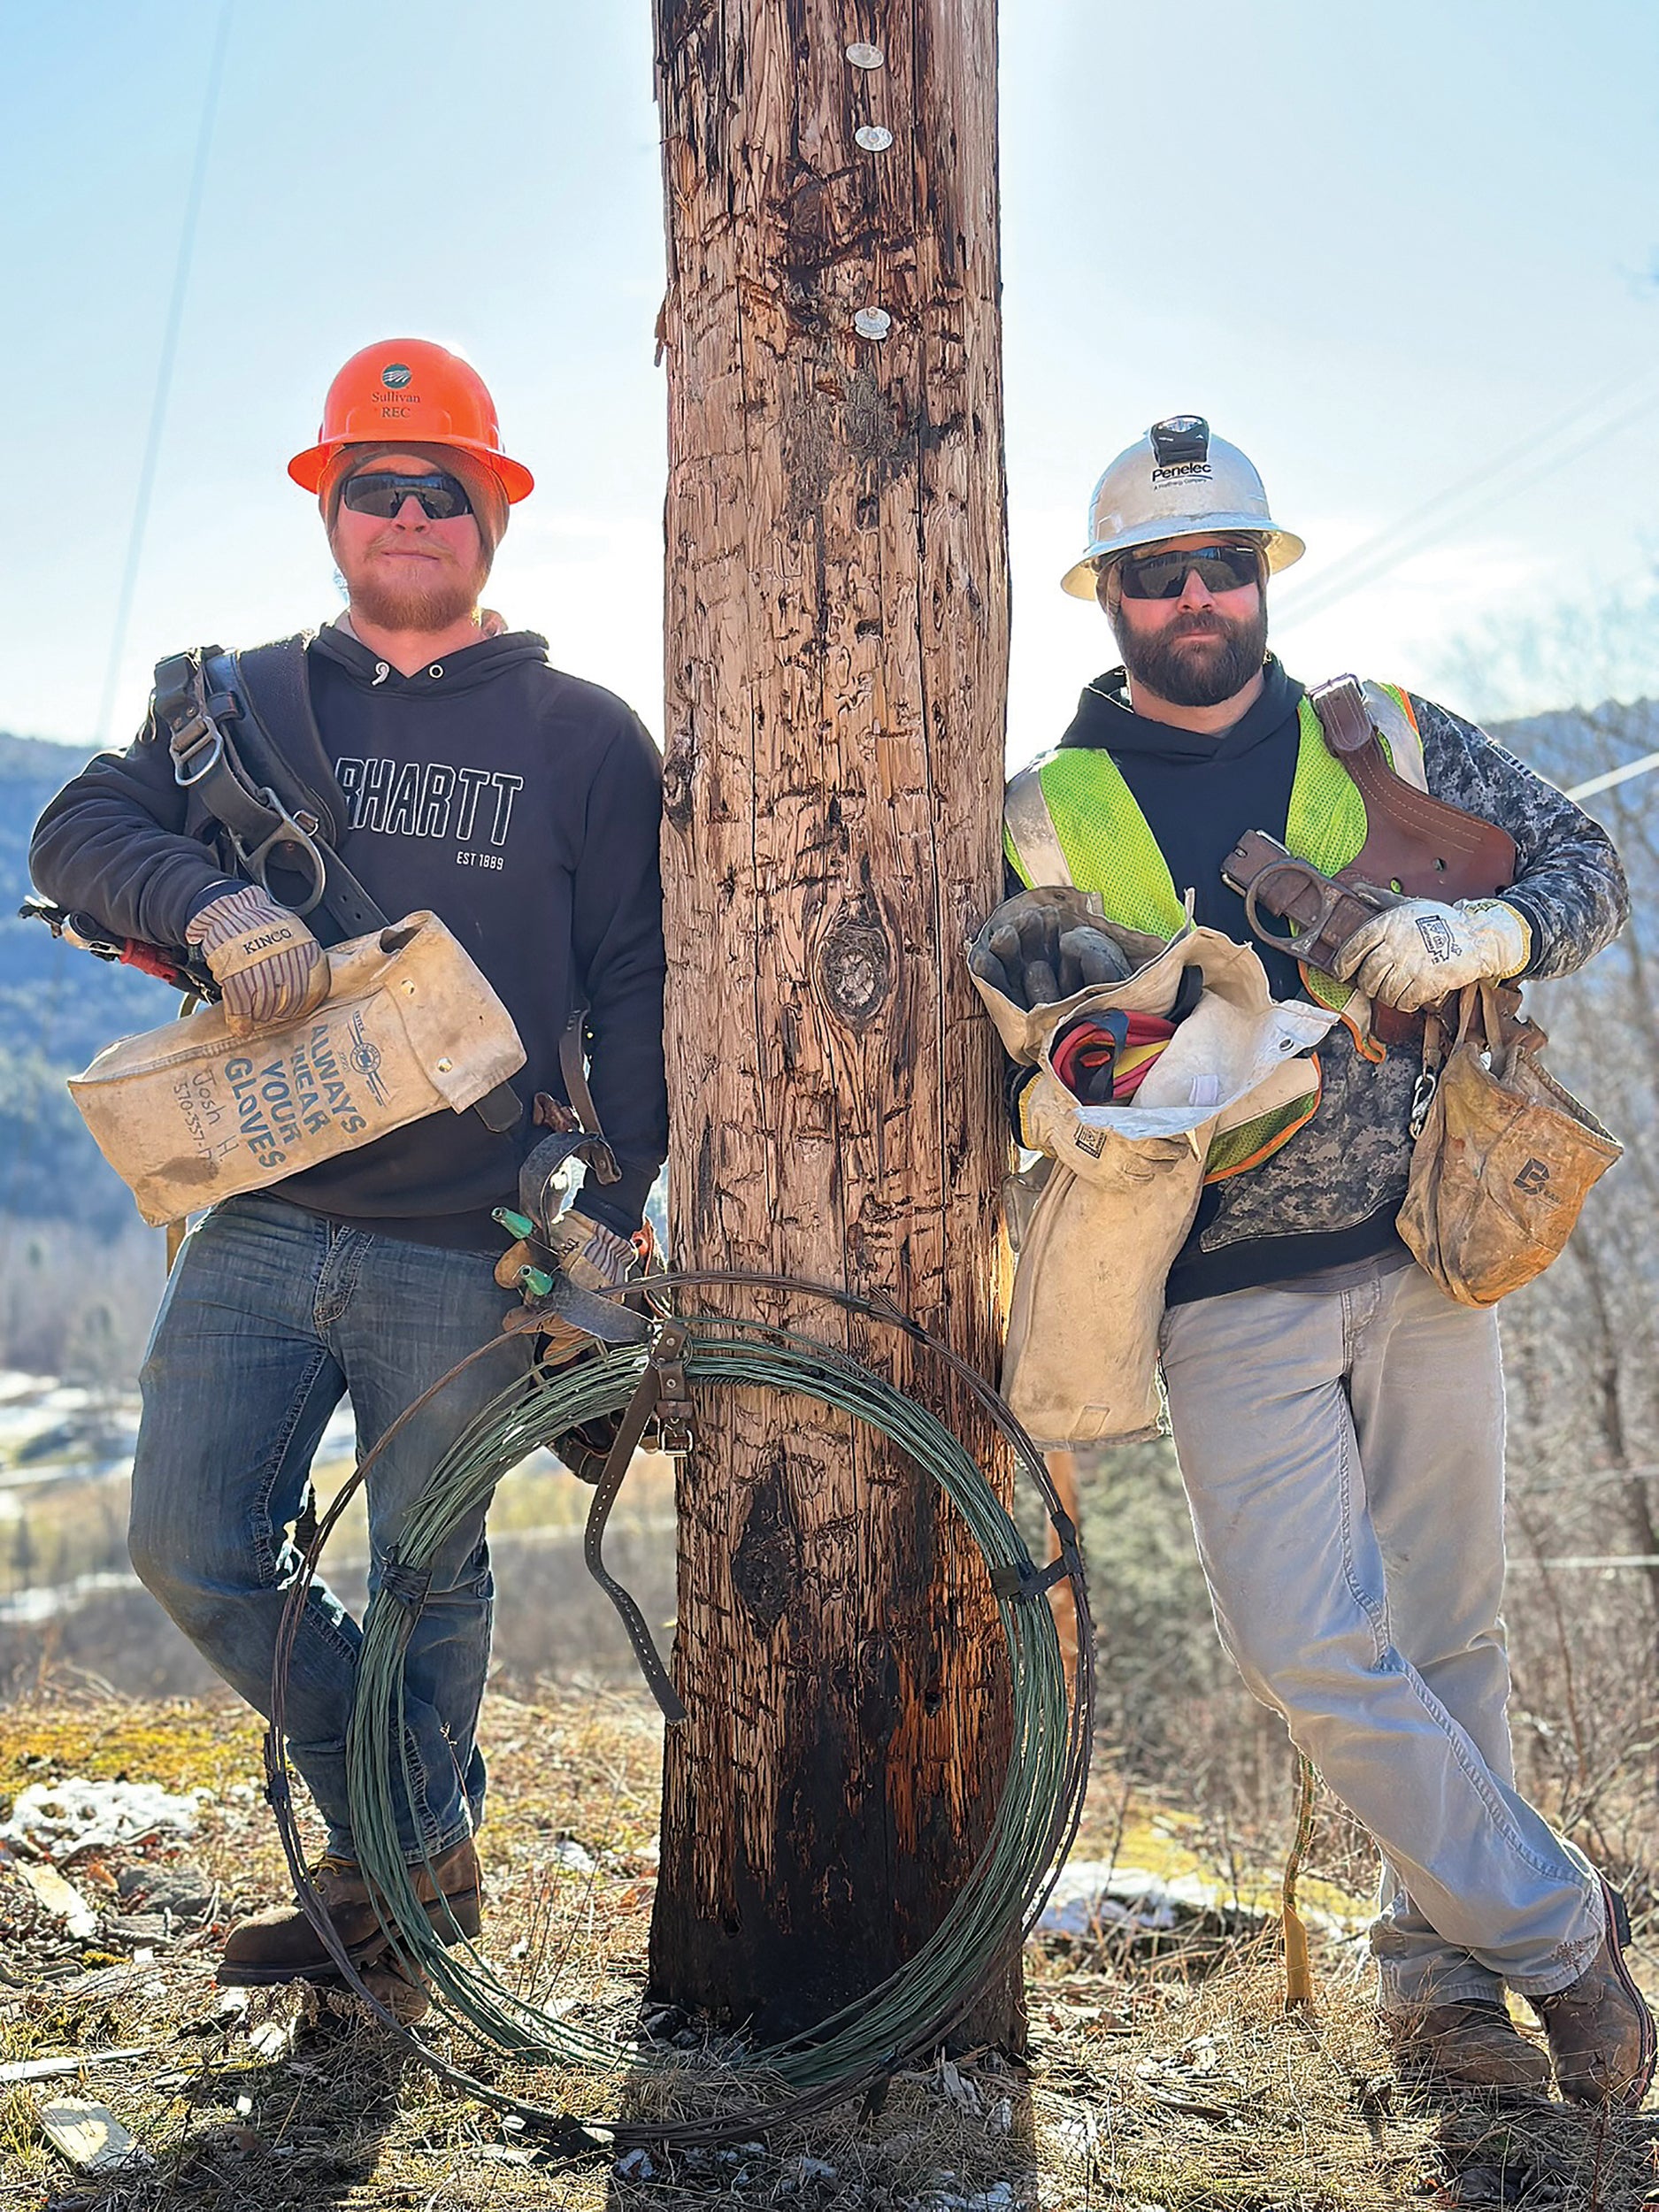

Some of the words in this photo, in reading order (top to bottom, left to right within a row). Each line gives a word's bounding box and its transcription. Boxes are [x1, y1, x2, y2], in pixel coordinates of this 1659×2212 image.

[372, 391, 421, 403] Sullivan
[381, 406, 411, 419] REC
[1152, 462, 1212, 482] Penelec
[457, 851, 477, 866] EST
[479, 853, 504, 871] 1889
[242, 928, 292, 955] KINCO
[260, 1059, 303, 1144] YOUR
[290, 1044, 331, 1135] WEAR
[311, 1024, 367, 1134] ALWAYS
[192, 1068, 227, 1125] Josh
[217, 1134, 240, 1163] H.
[225, 1057, 287, 1168] GLOVES
